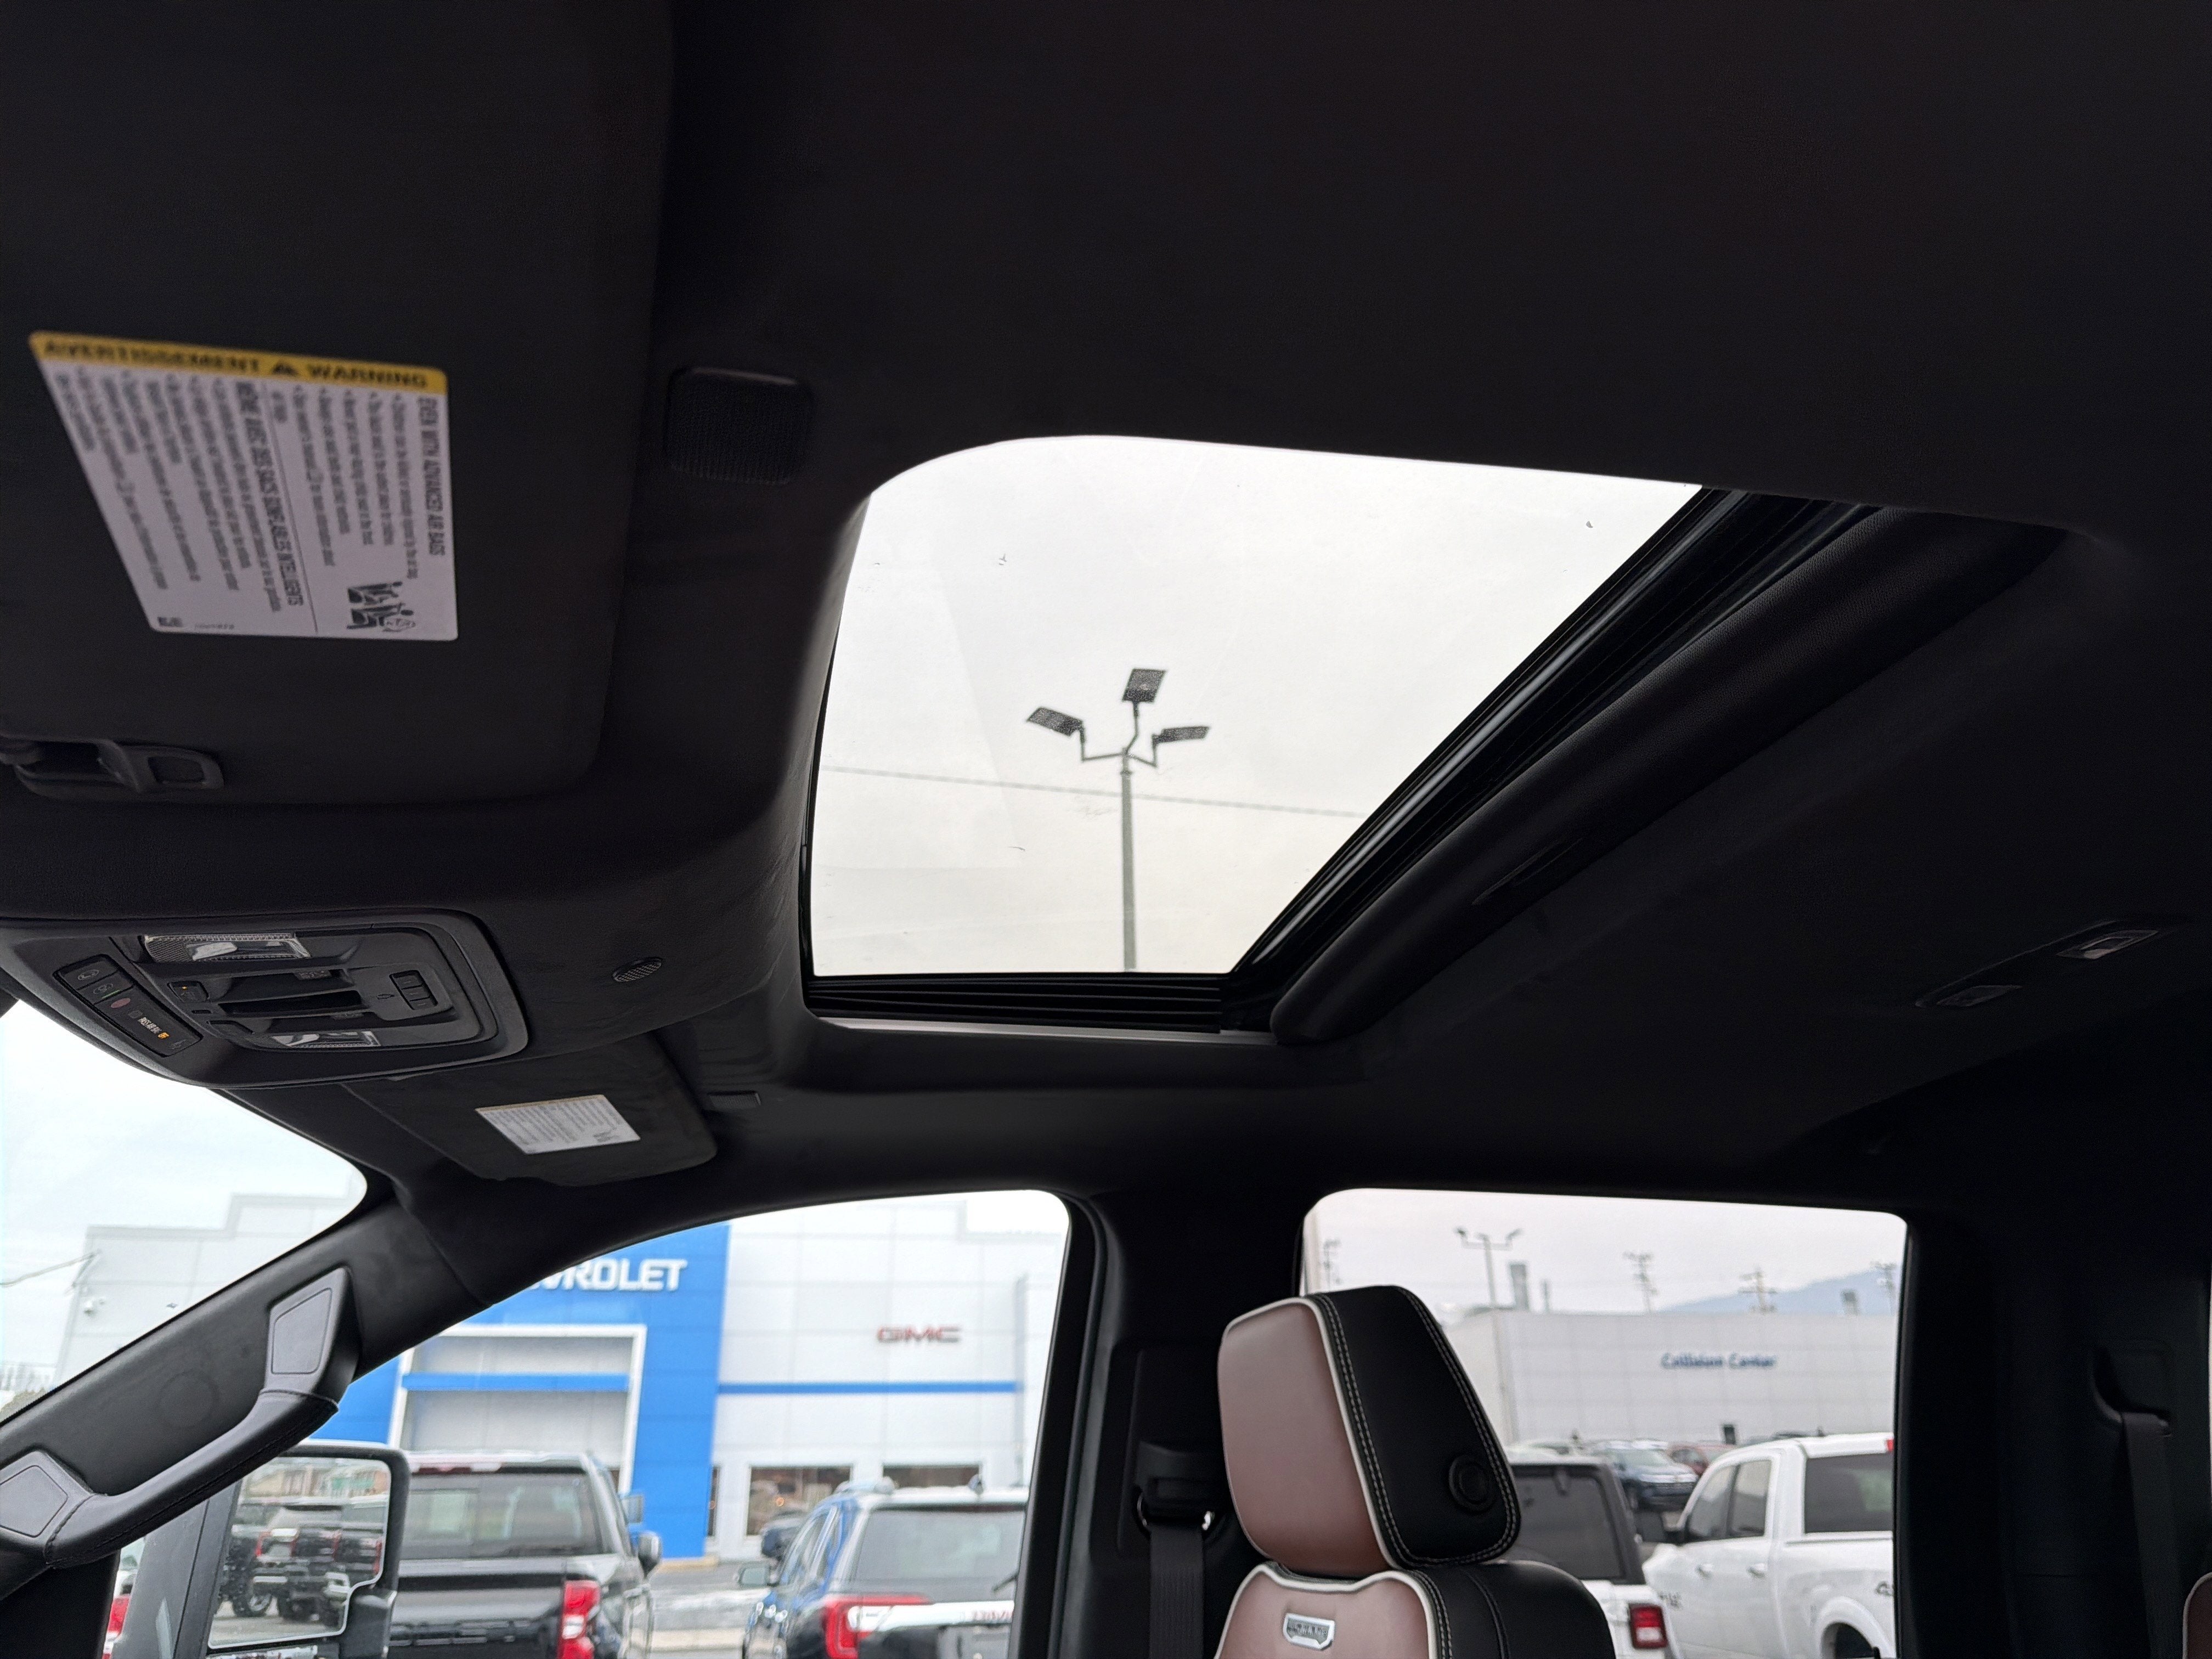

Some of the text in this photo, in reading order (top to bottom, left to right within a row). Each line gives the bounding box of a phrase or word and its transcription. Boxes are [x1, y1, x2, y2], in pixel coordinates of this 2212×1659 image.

[45, 340, 427, 388] AVERTISSEMENT WARNING
[877, 1324, 961, 1344] GMC
[1661, 1352, 1778, 1369] Collision Center
